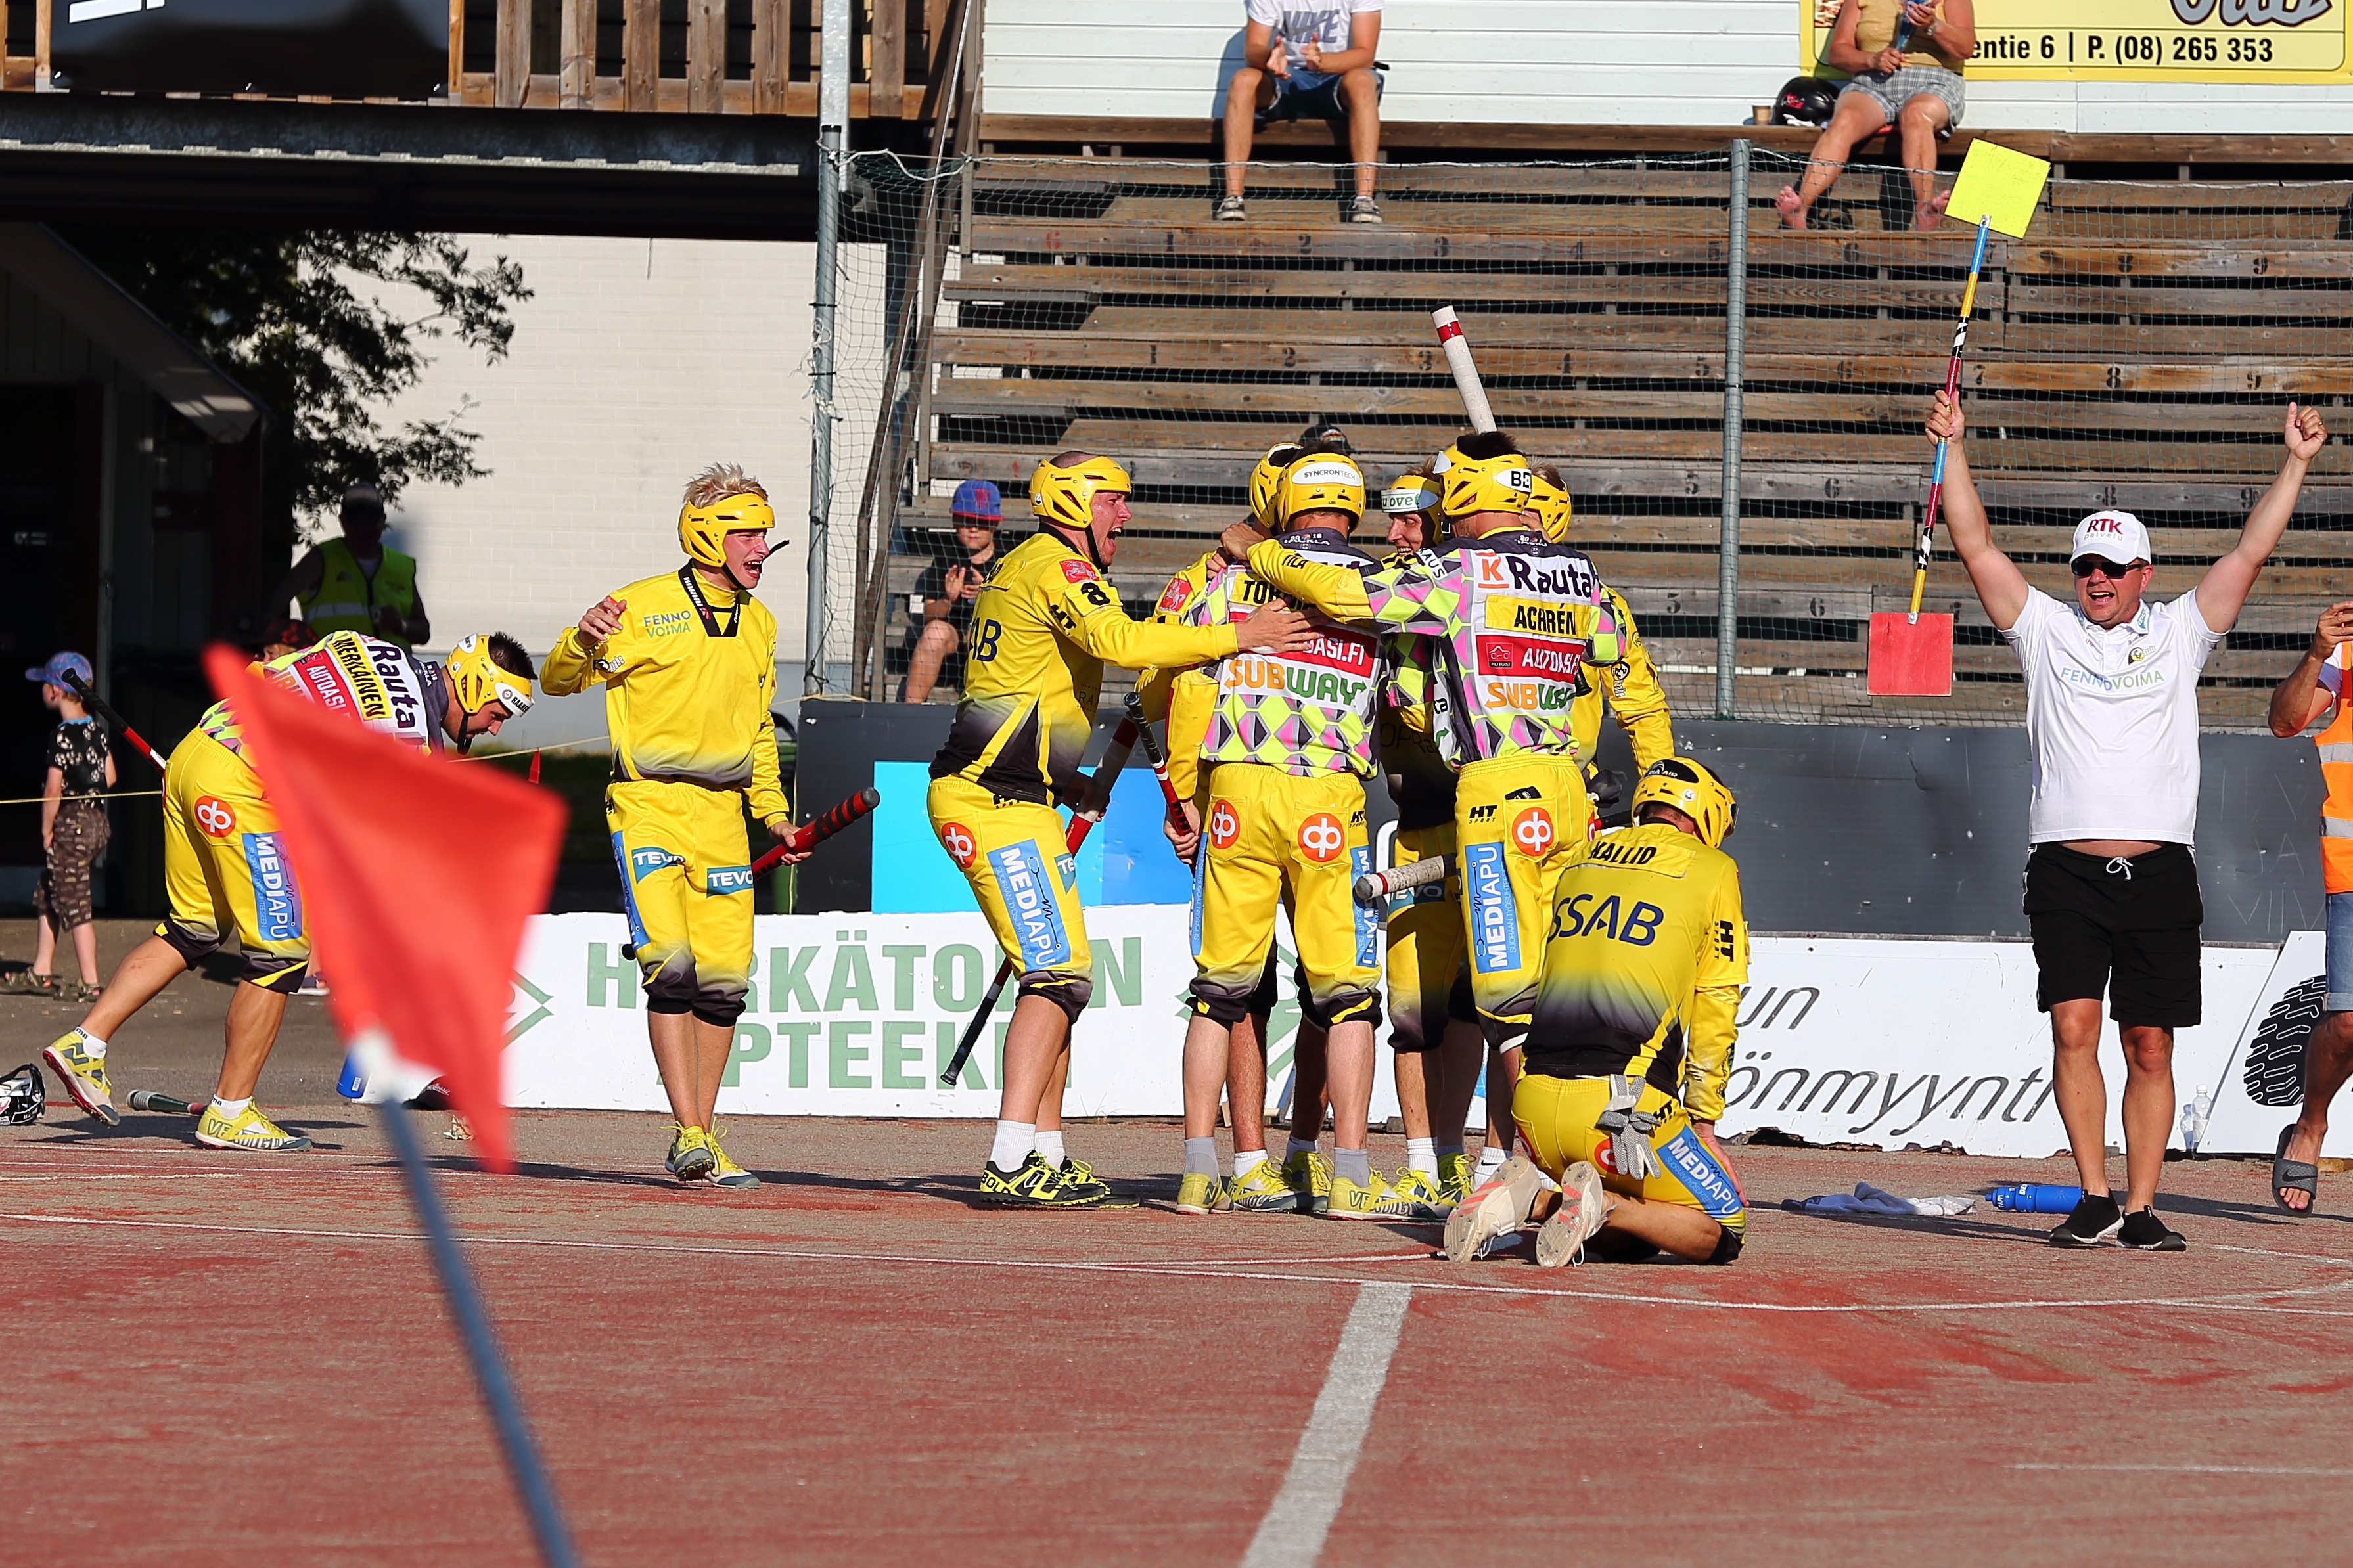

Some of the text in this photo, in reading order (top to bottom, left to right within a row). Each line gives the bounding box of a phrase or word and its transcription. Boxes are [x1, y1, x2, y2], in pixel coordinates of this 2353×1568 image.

[1971, 35, 2273, 65] entie 6 P. (08) 265 353
[2106, 366, 2122, 389] 8
[1304, 469, 1356, 481] SYNCRONTECH
[2084, 529, 2124, 541] palvelu
[2087, 518, 2124, 535] RTK
[1505, 555, 1591, 598] Rauta
[1080, 581, 1111, 606] 8
[643, 610, 691, 627] FENNO
[645, 621, 691, 638] VOIMA
[1514, 602, 1576, 635] ACHRÉN
[367, 645, 420, 728] Rauta
[1224, 660, 1367, 706] SUBWAY
[2060, 667, 2165, 692] FENNOVOIMA
[1469, 805, 1498, 818] HT
[1588, 840, 1657, 866] KALLIO
[255, 836, 288, 939] MEDIAPU
[708, 869, 754, 887] TEVO
[999, 847, 1056, 966] MEDIAPU
[1478, 846, 1509, 969] MEDIAPU
[1720, 920, 1734, 962] HT
[1667, 1136, 1740, 1215] MEDIAPU
